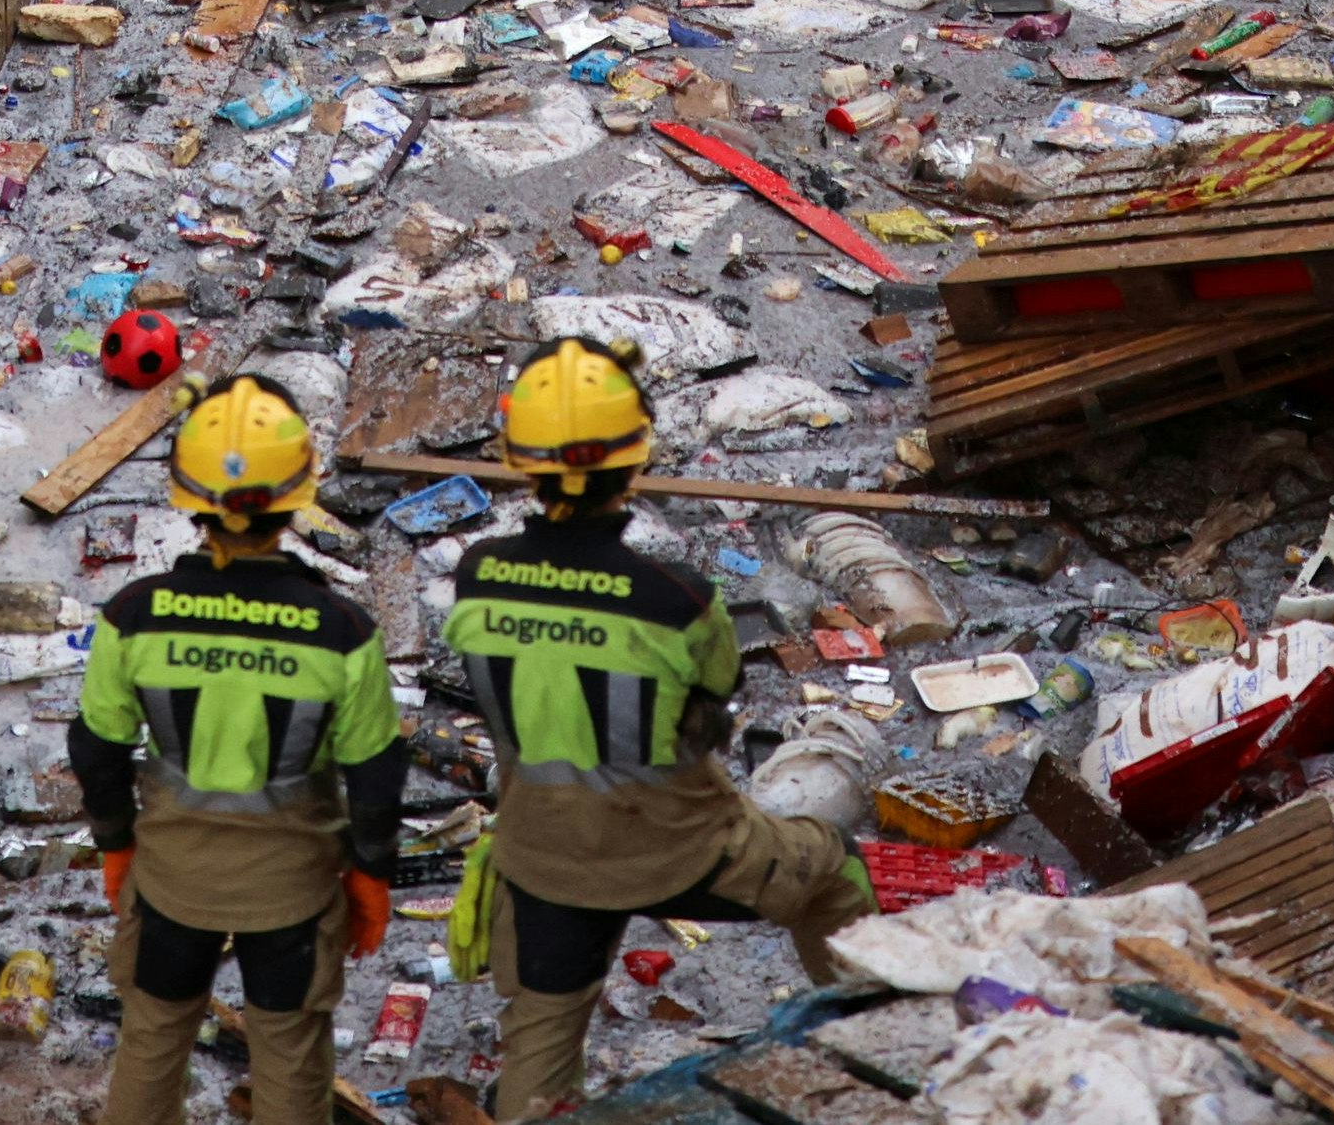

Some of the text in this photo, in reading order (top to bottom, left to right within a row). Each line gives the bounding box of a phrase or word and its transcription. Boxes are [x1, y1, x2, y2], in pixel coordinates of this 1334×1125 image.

[476, 555, 632, 597] Bomberos
[151, 588, 320, 631] Bomberos
[483, 607, 608, 646] Logroño
[167, 640, 298, 677] Logroño
